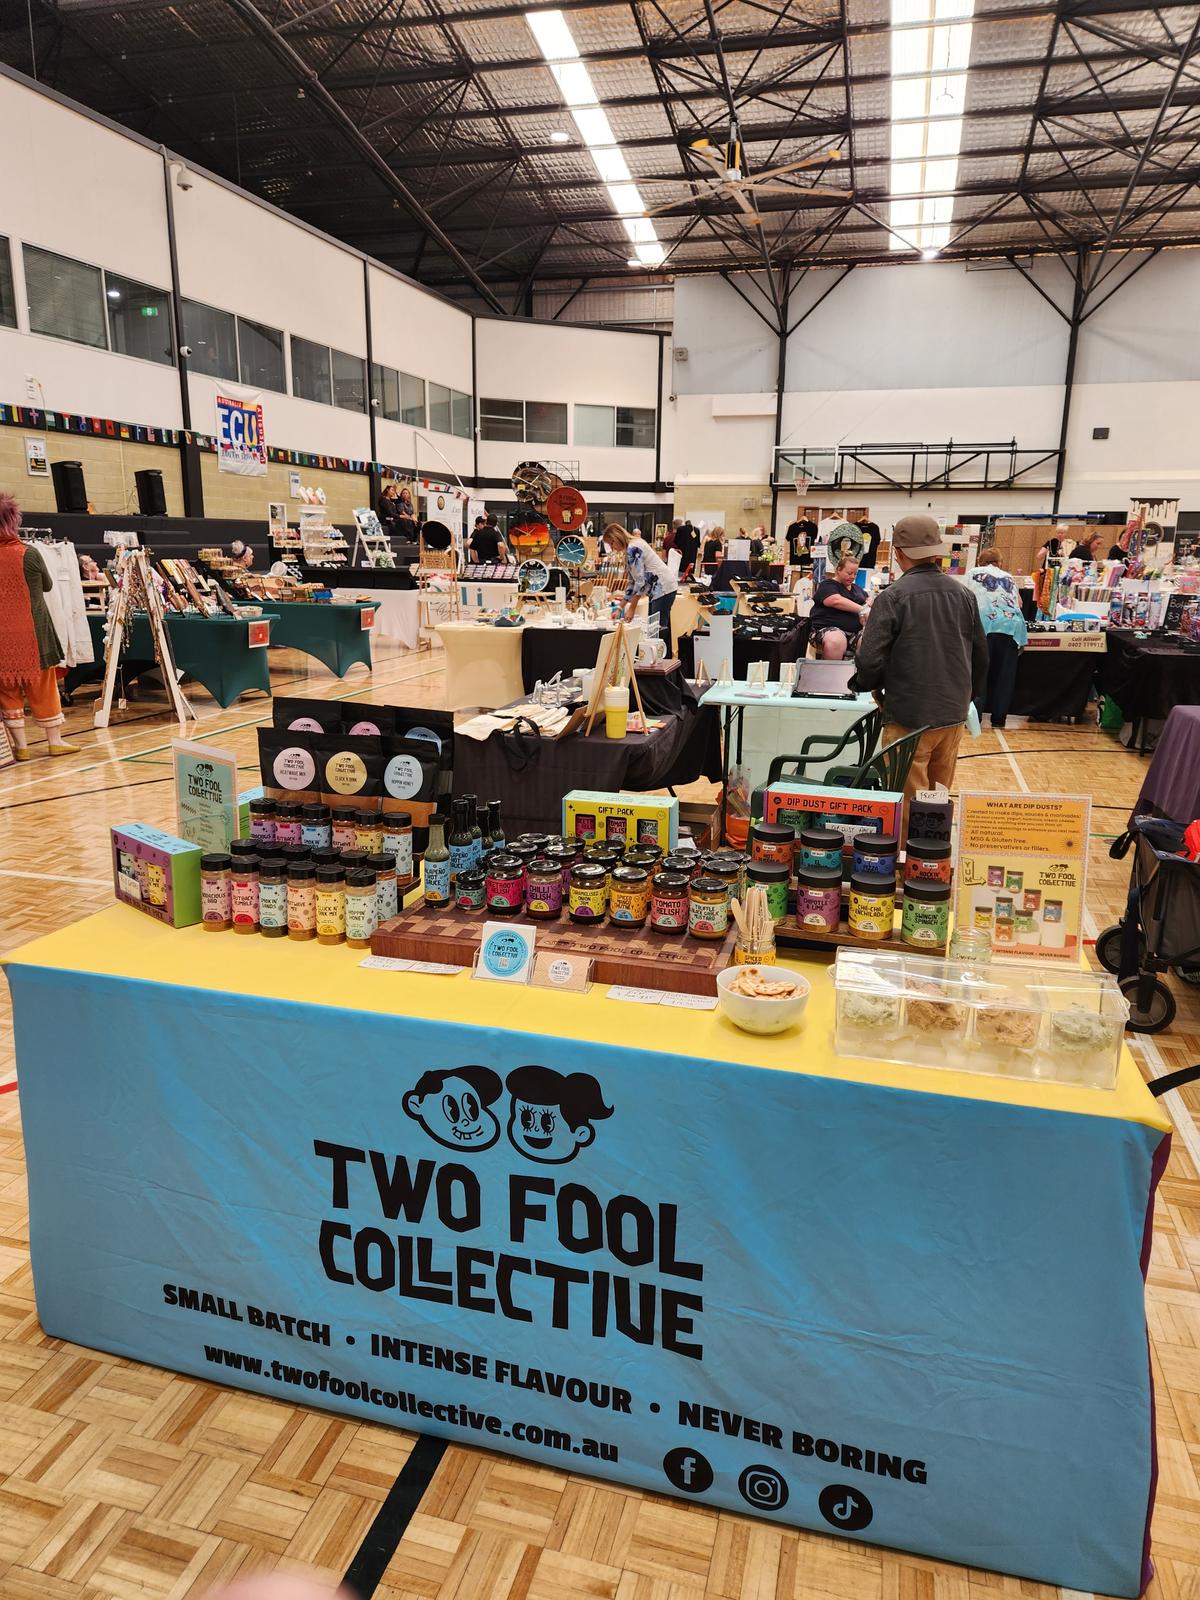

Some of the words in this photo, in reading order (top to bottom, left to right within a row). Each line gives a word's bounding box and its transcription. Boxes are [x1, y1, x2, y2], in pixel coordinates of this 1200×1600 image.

[216, 407, 258, 448] ECU
[187, 774, 204, 787] TWO
[205, 779, 222, 793] FOOL
[188, 785, 223, 804] COLLECTIVE
[787, 797, 801, 806] DIP
[803, 799, 826, 809] DUST
[829, 802, 848, 811] GIFT
[852, 804, 873, 813] PACK
[598, 806, 614, 814] GIFT
[617, 808, 634, 816] PACK
[979, 843, 1022, 851] preservatives
[1039, 879, 1076, 887] COLLECTIVE
[529, 885, 550, 894] CHILLI
[529, 892, 552, 901] RELISH
[655, 899, 681, 909] TOMATO
[857, 904, 882, 912] CHA-CHA
[656, 907, 680, 916] RELISH
[855, 908, 884, 918] ENCHILADA
[915, 918, 938, 926] SPINACH
[492, 951, 518, 959] COLLECTIVE
[573, 940, 596, 951] TWO
[598, 943, 628, 954] FOOL
[629, 949, 691, 961] COLLECTIVE
[314, 1140, 481, 1233] TWO
[509, 1174, 703, 1281] FOOL
[319, 1220, 703, 1360] COLLECTIVE
[163, 1284, 244, 1323] SMALL
[247, 1305, 331, 1347] BATCH
[371, 1334, 488, 1381] INTENSE
[495, 1360, 633, 1415] FLAVOUR
[679, 1400, 783, 1449] NEVER
[792, 1431, 928, 1485] BORING
[204, 1345, 619, 1463] www.twofoolcollective.com.au
